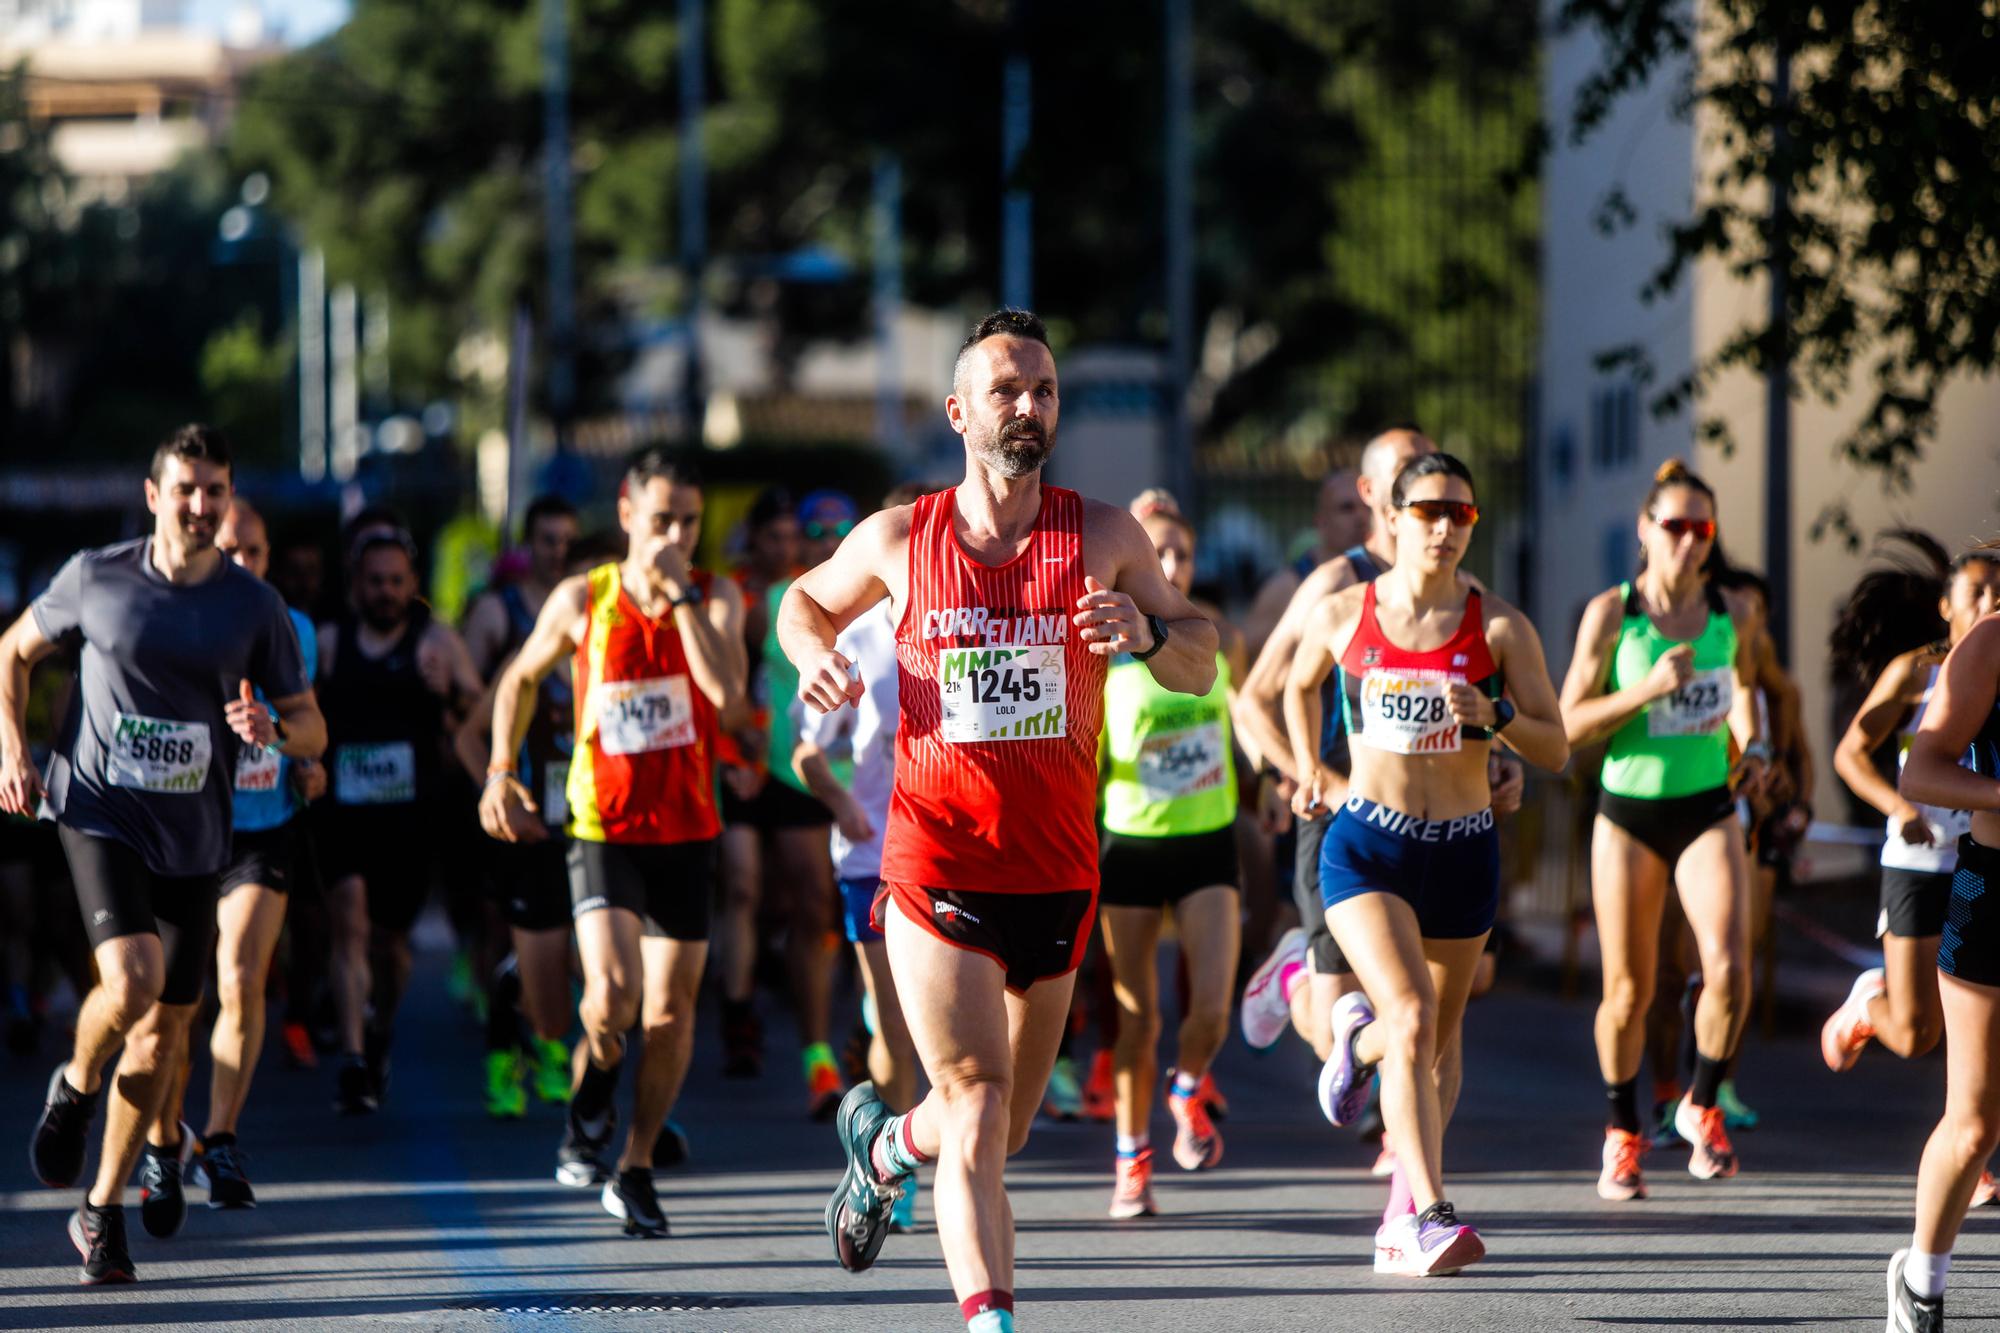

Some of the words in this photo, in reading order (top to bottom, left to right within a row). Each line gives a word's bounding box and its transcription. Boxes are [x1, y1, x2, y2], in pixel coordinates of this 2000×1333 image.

[923, 606, 1069, 648] CORRELIANA
[967, 667, 1041, 704] 1245
[995, 705, 1017, 716] LOLO
[1381, 693, 1445, 723] 5928
[131, 734, 194, 766] 5868
[1366, 804, 1442, 842] NIKE
[1446, 807, 1494, 841] PRO
